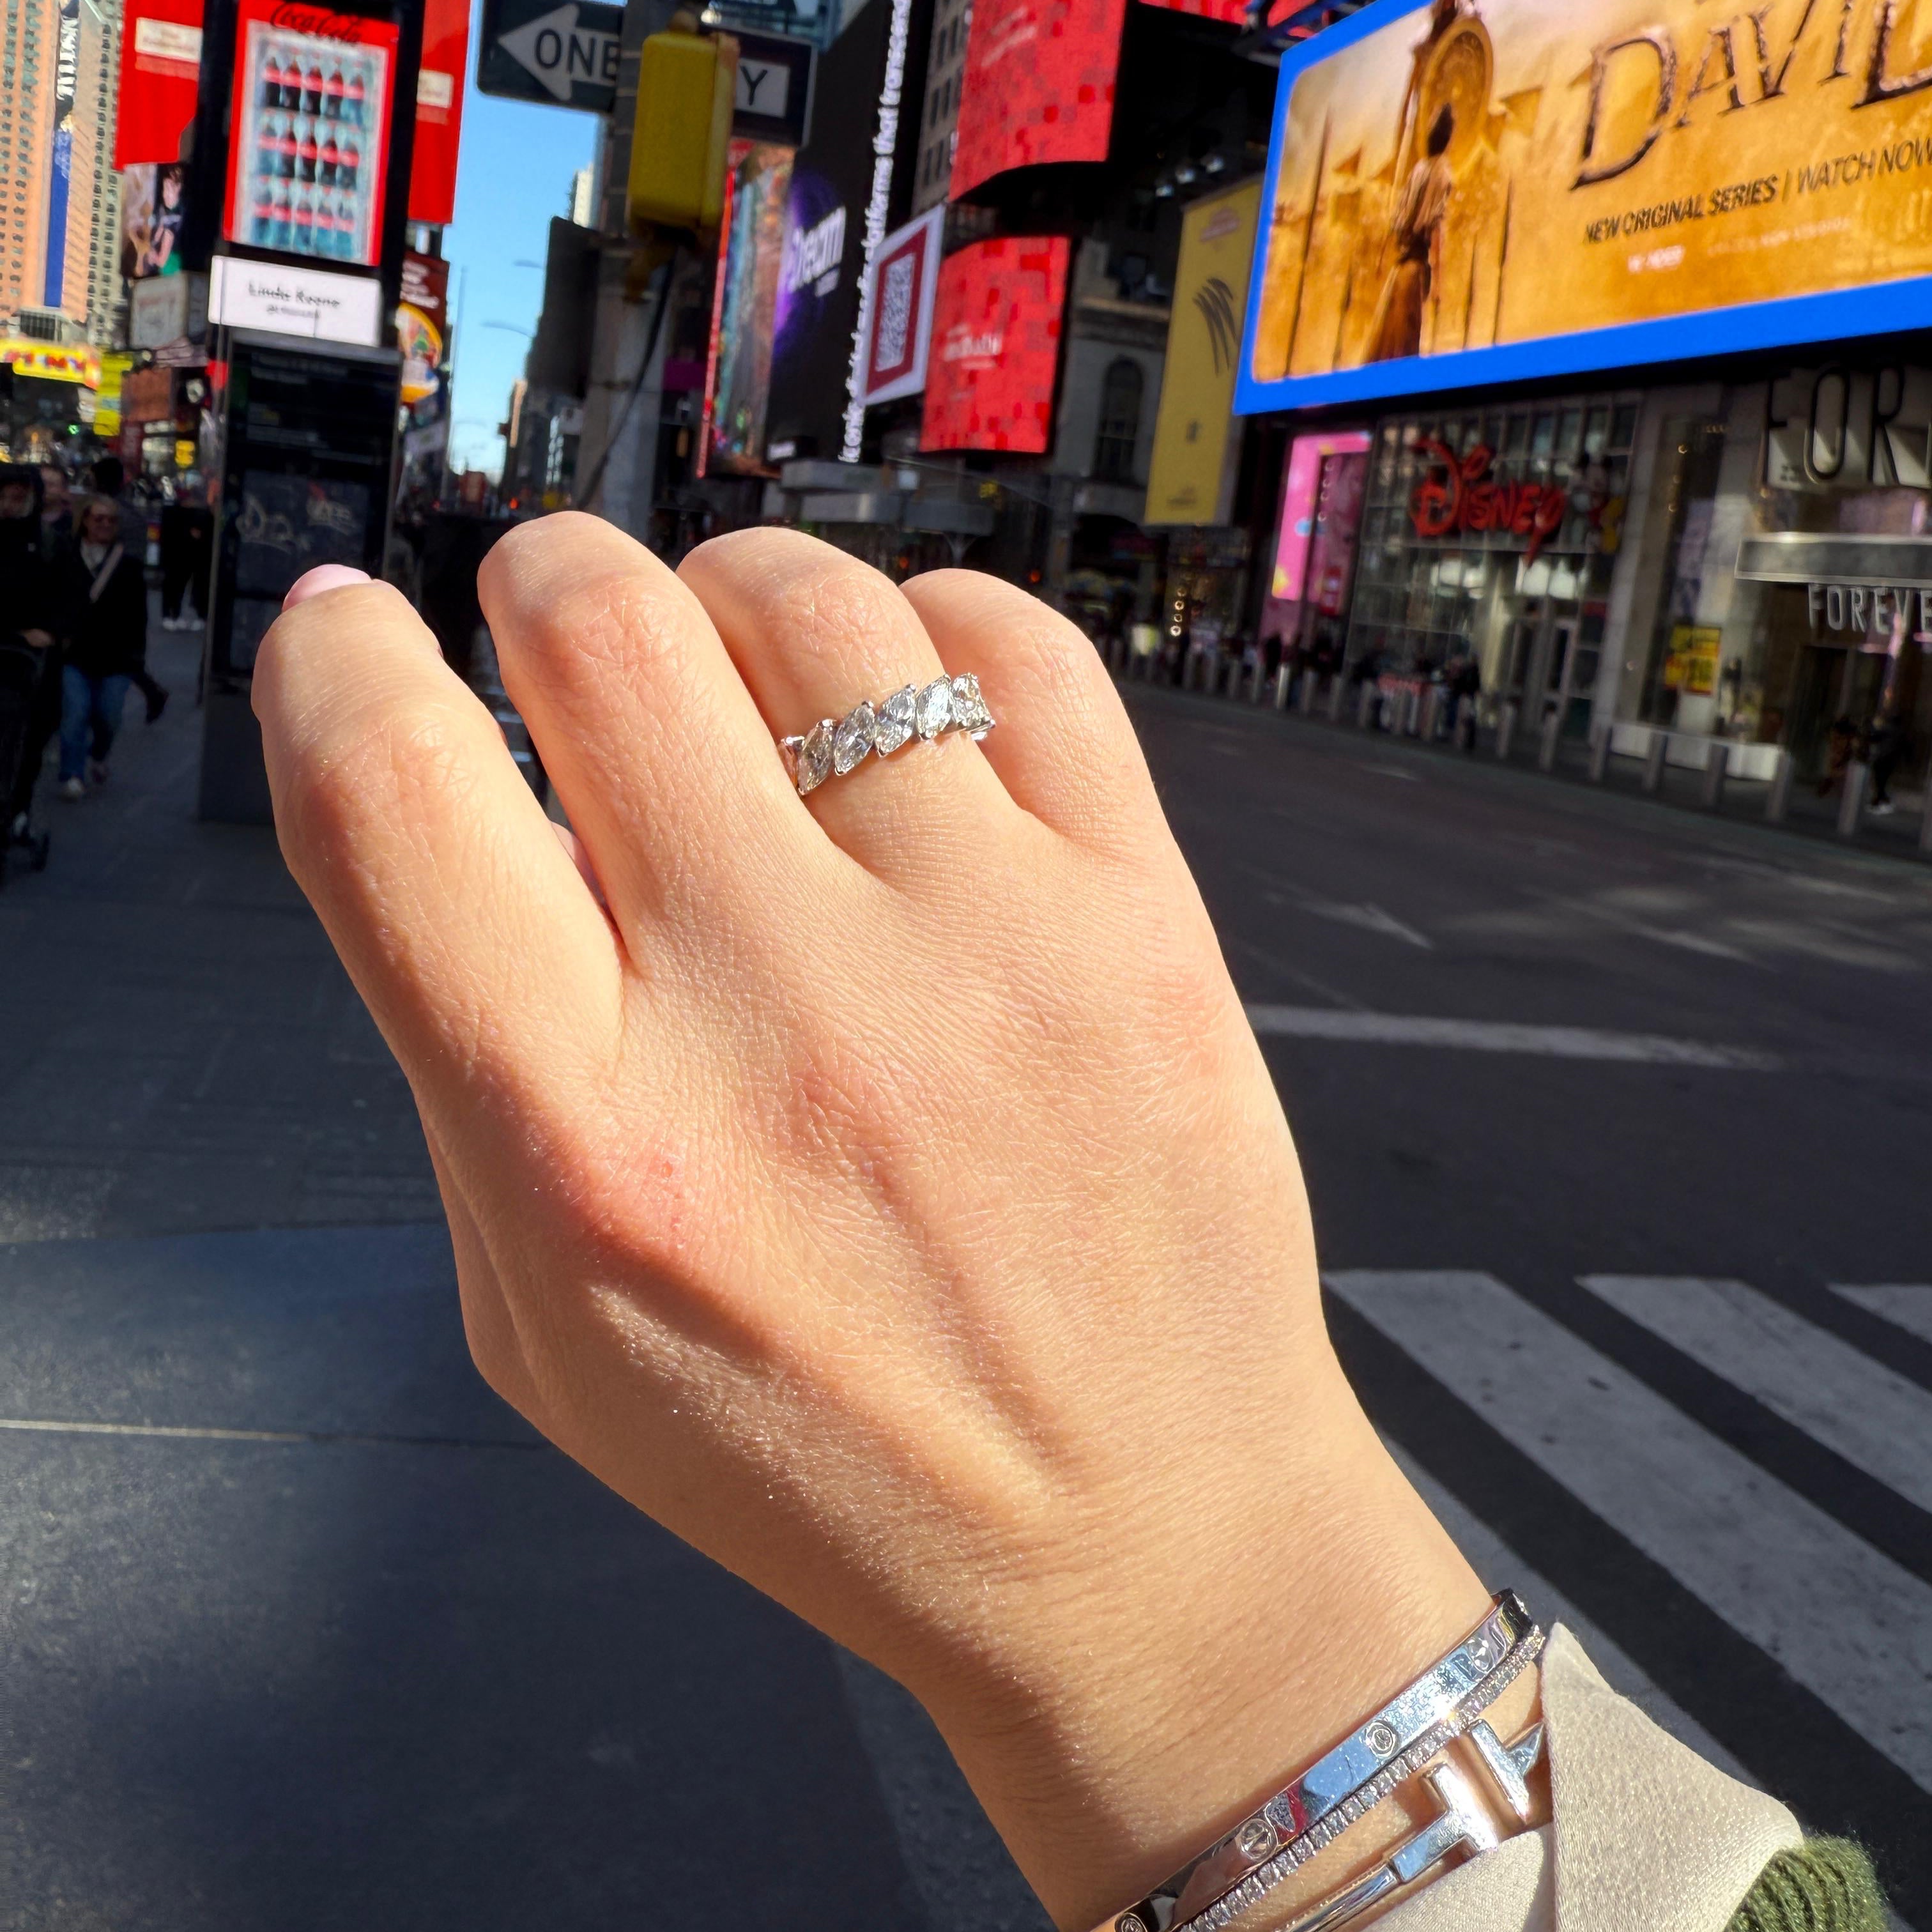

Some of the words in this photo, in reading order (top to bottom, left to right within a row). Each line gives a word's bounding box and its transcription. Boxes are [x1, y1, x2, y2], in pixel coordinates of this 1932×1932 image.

[1585, 215, 1619, 243] NEW
[1623, 194, 1705, 236] ORIGINAL
[1708, 174, 1778, 215] SERIES
[1798, 148, 1876, 194] WATCH
[1762, 362, 1932, 487] FOR
